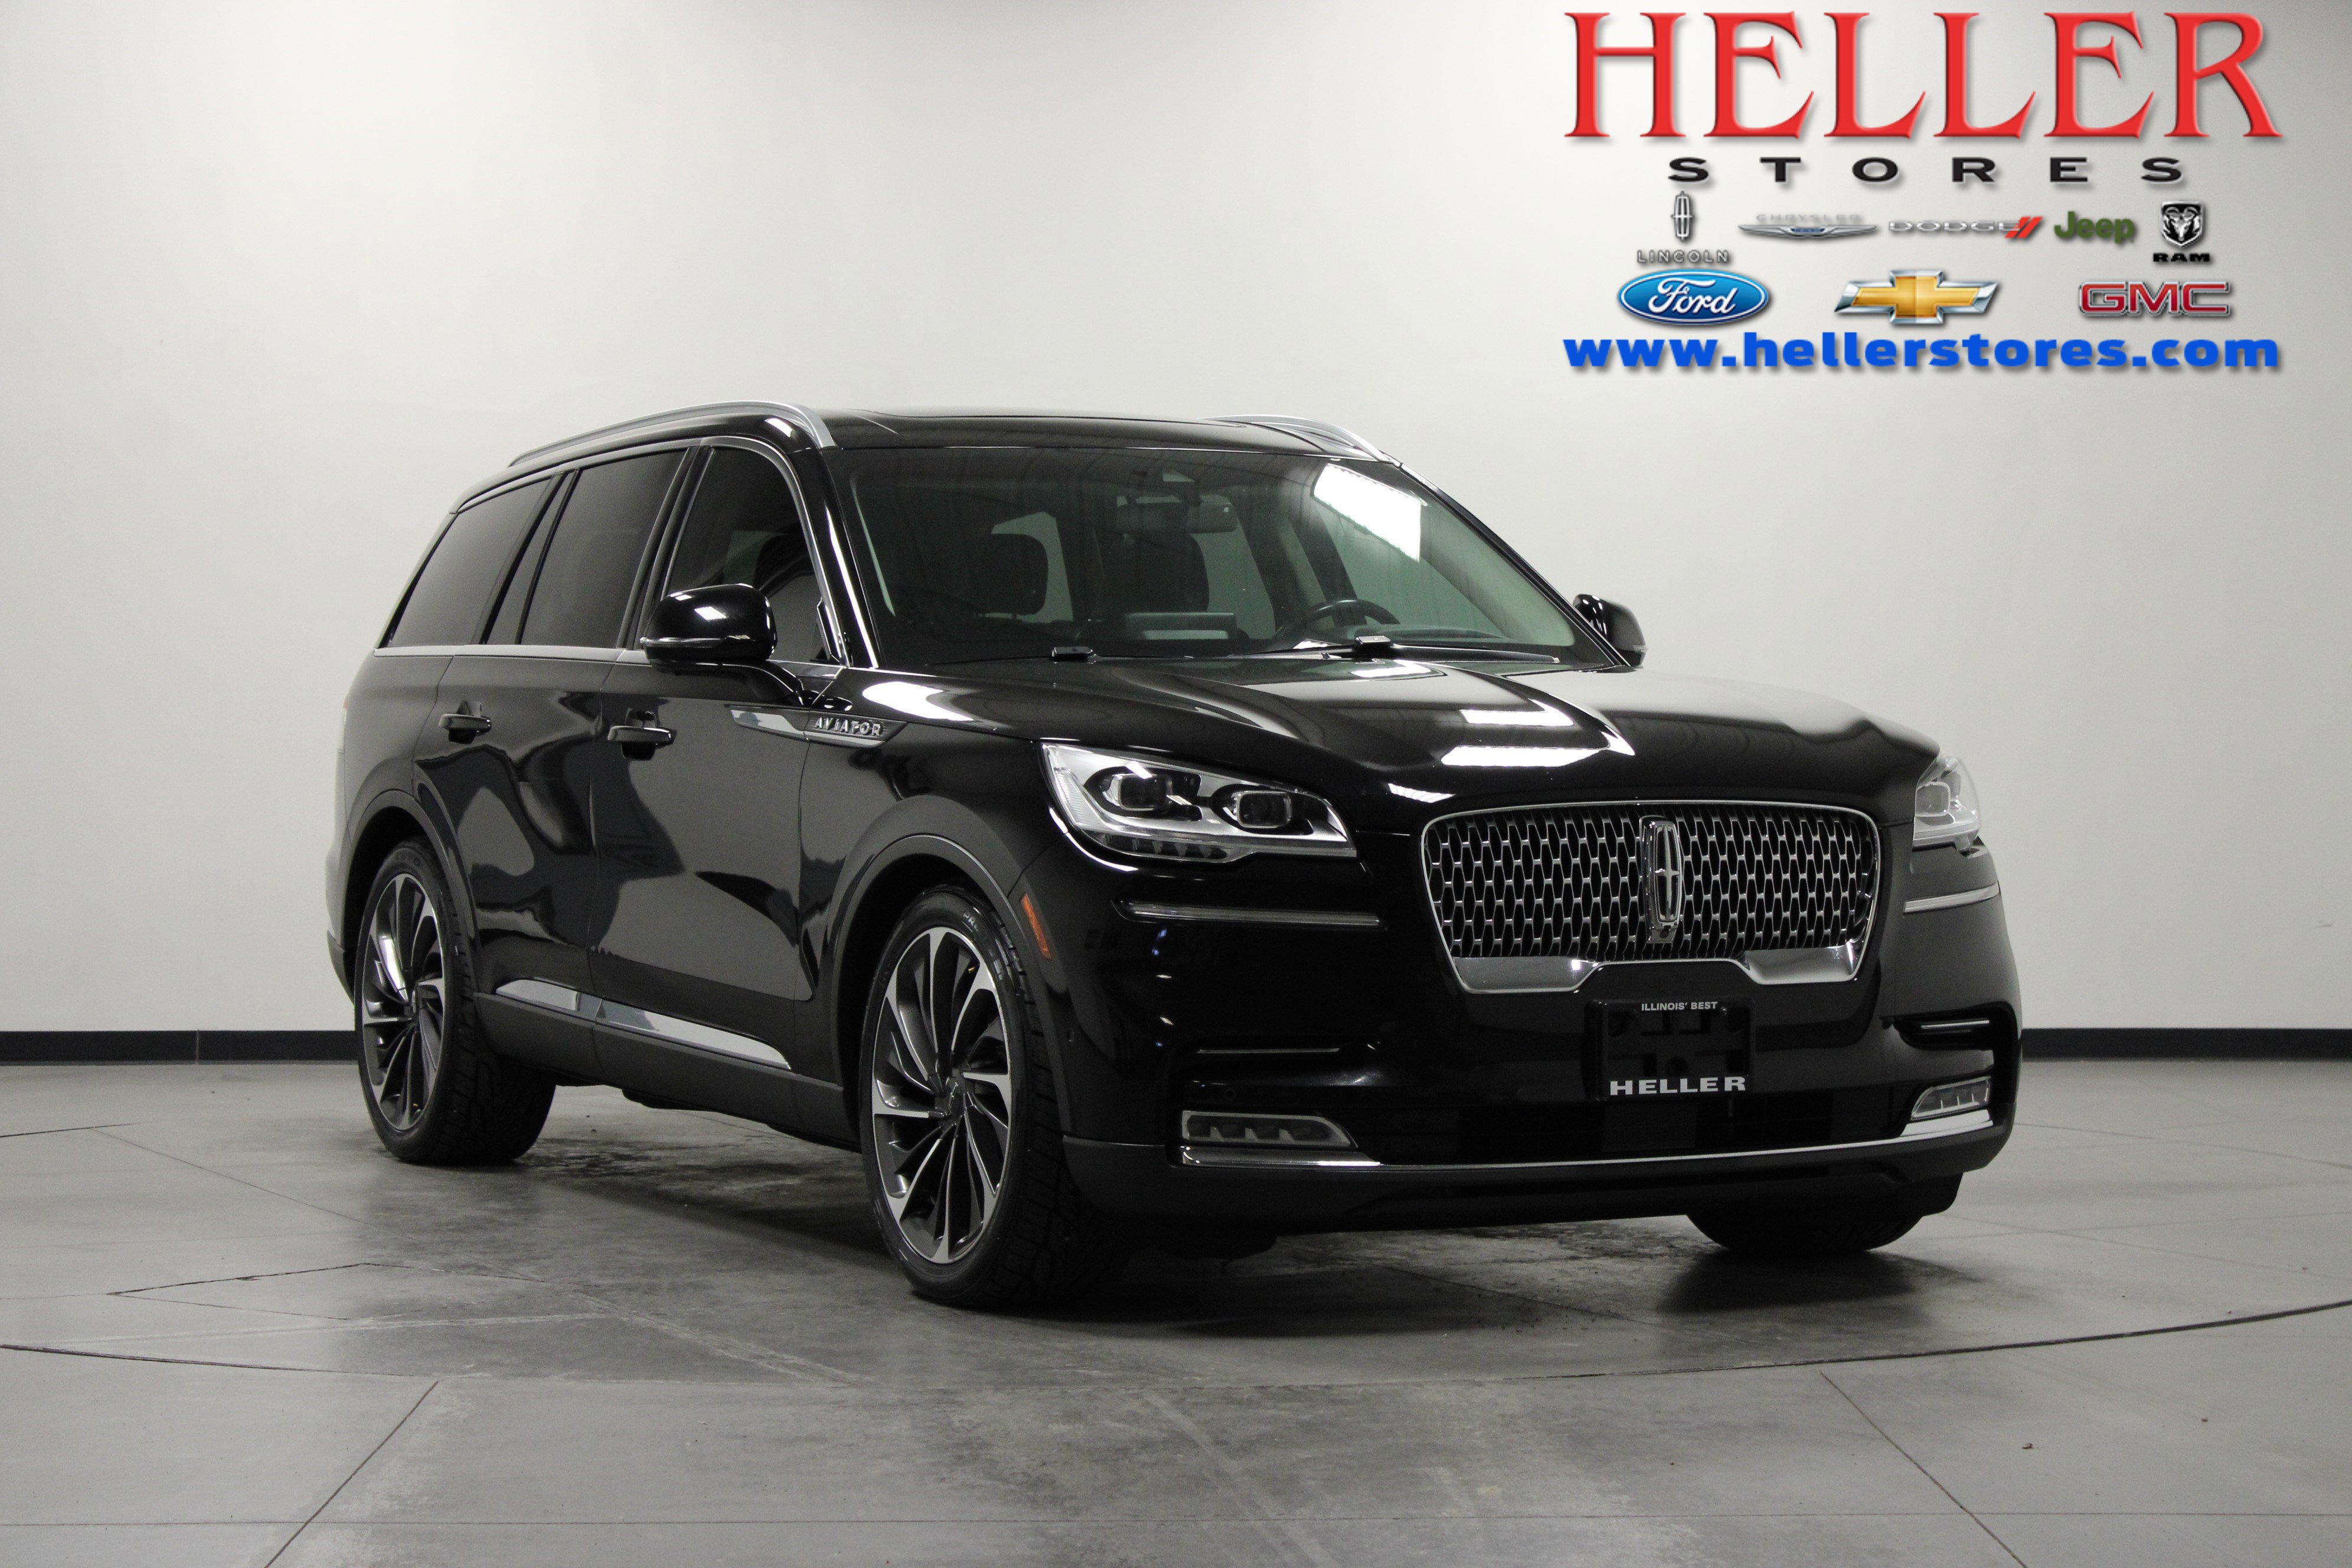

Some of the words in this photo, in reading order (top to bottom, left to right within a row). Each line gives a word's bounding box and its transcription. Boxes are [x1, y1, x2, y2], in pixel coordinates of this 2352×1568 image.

[814, 716, 883, 737] AVIATOR
[1691, 1001, 1718, 1010] BEST
[1610, 1076, 1746, 1096] HELLER
